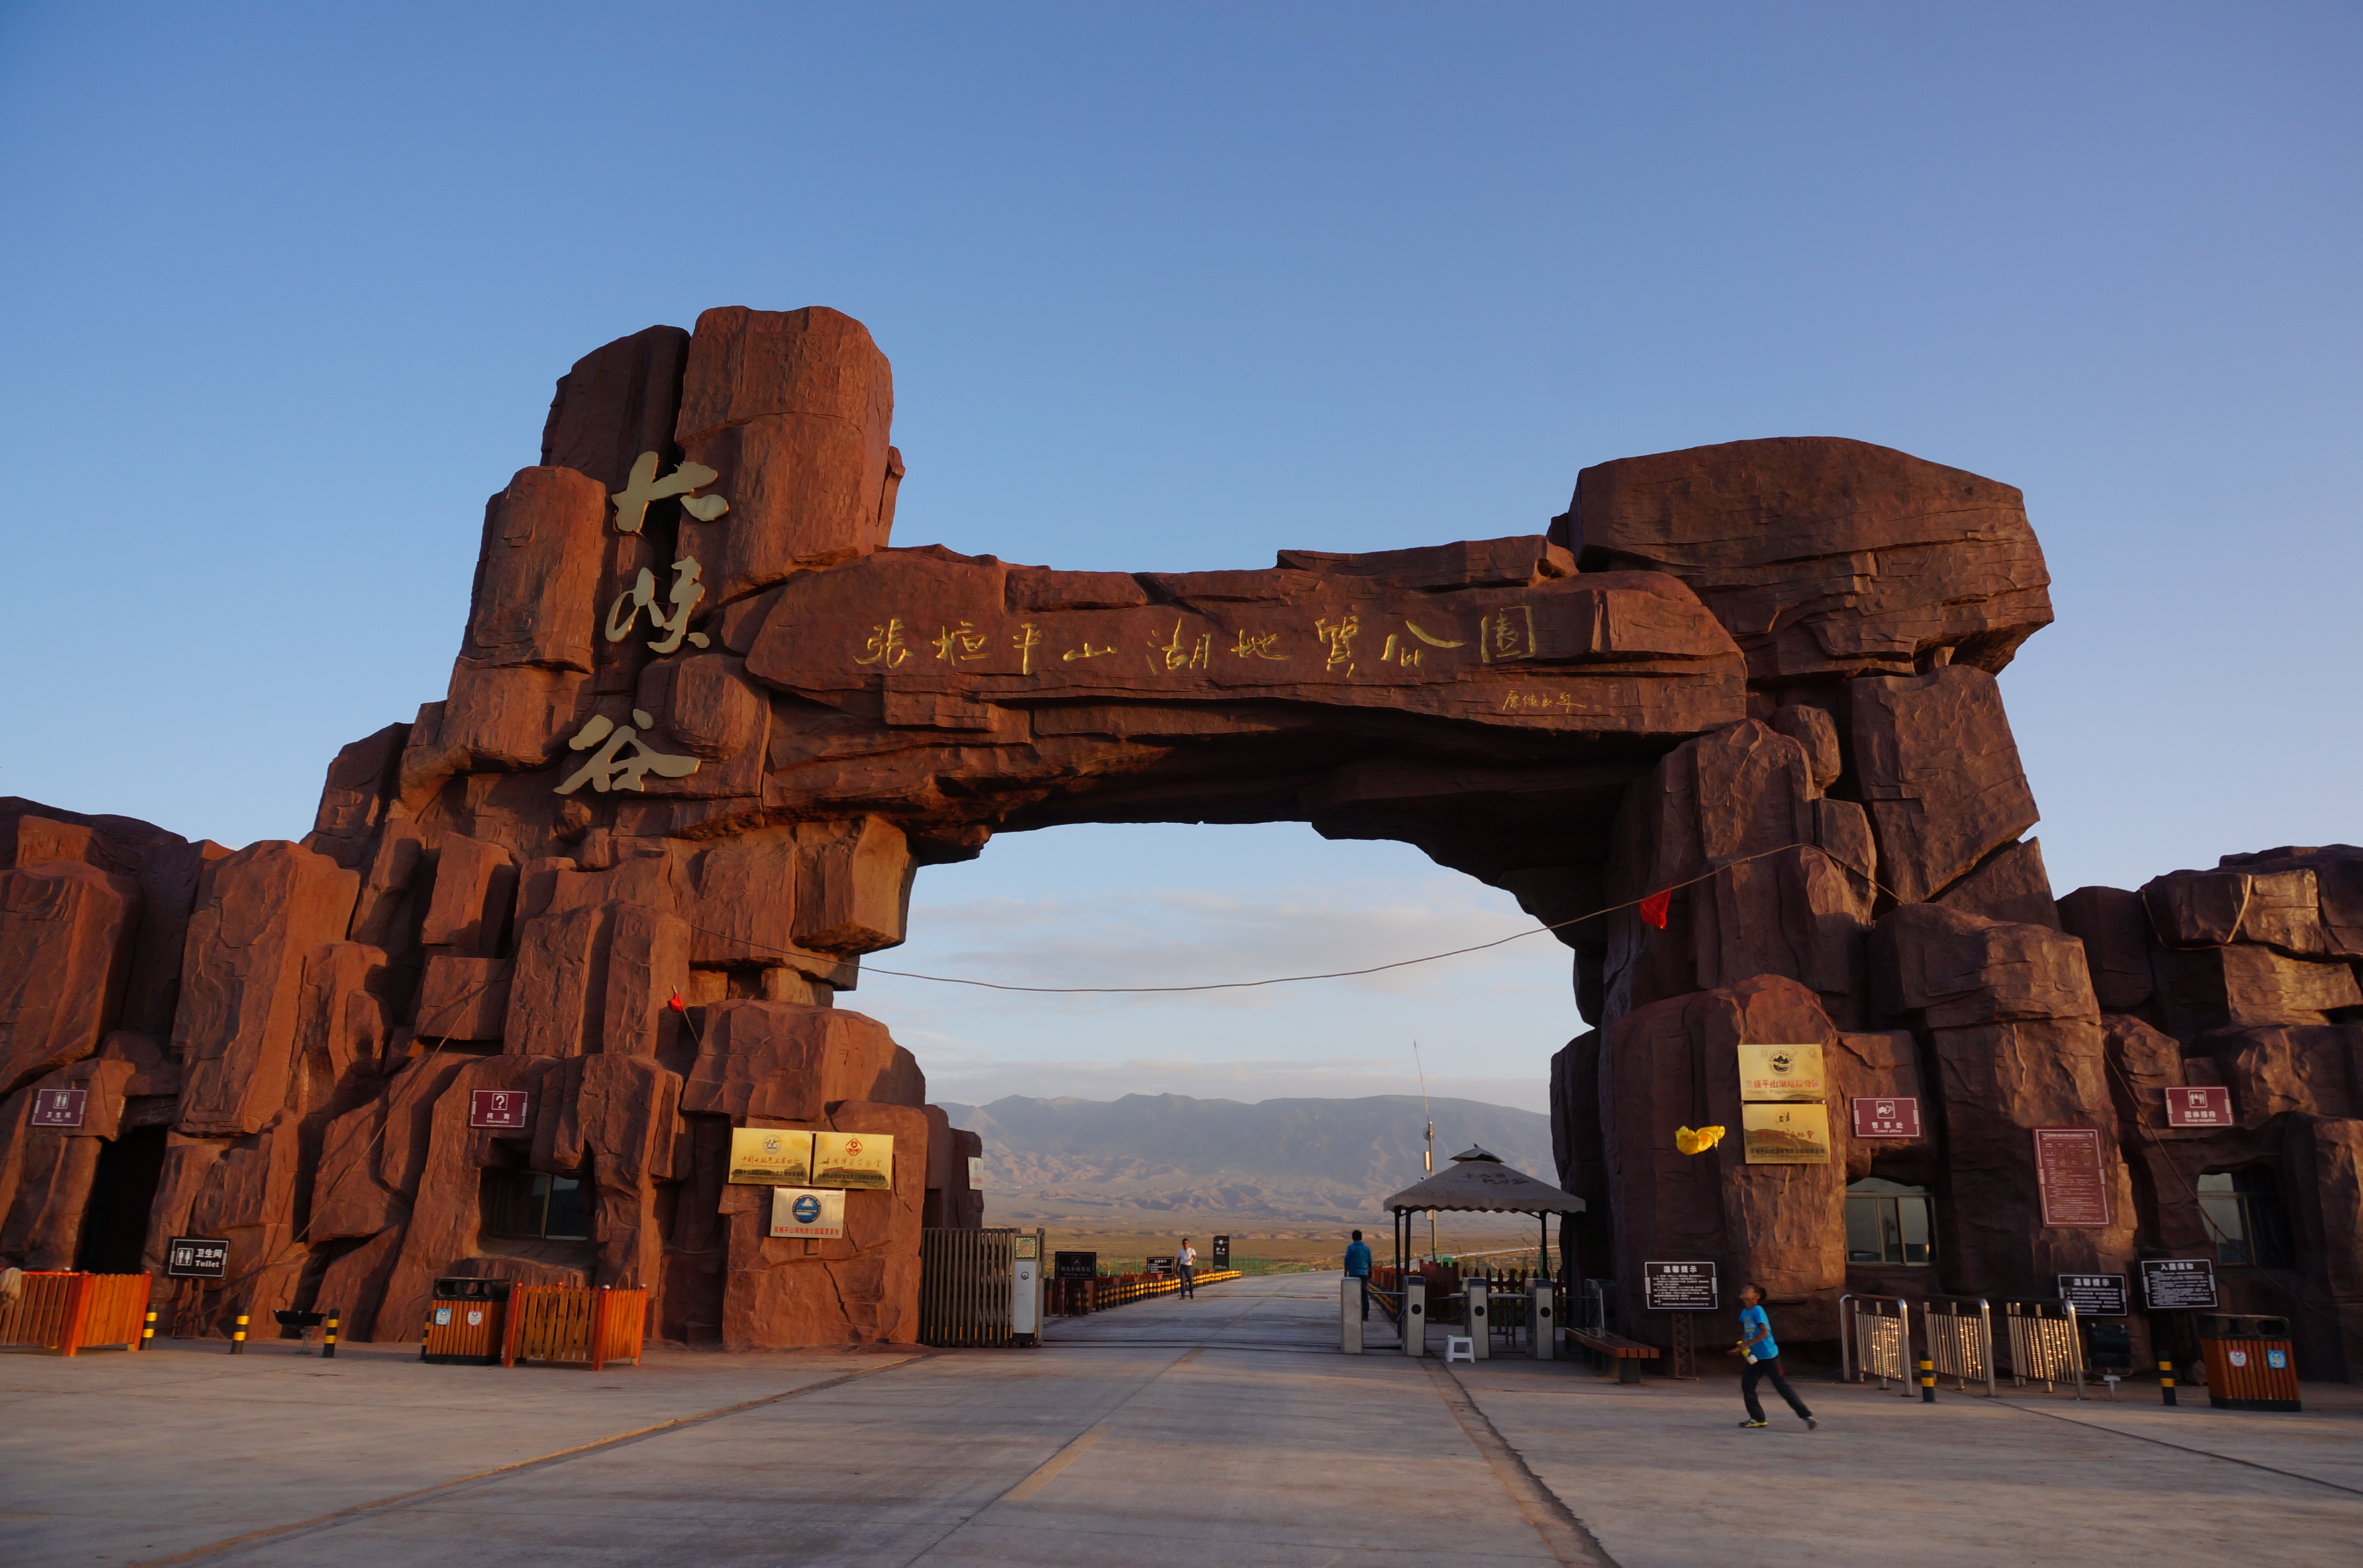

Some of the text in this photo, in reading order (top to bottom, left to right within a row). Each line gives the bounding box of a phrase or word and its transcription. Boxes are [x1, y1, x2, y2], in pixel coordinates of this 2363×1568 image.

[195, 1248, 224, 1259] 卫生间
[1663, 1265, 1697, 1273] 温馨提示
